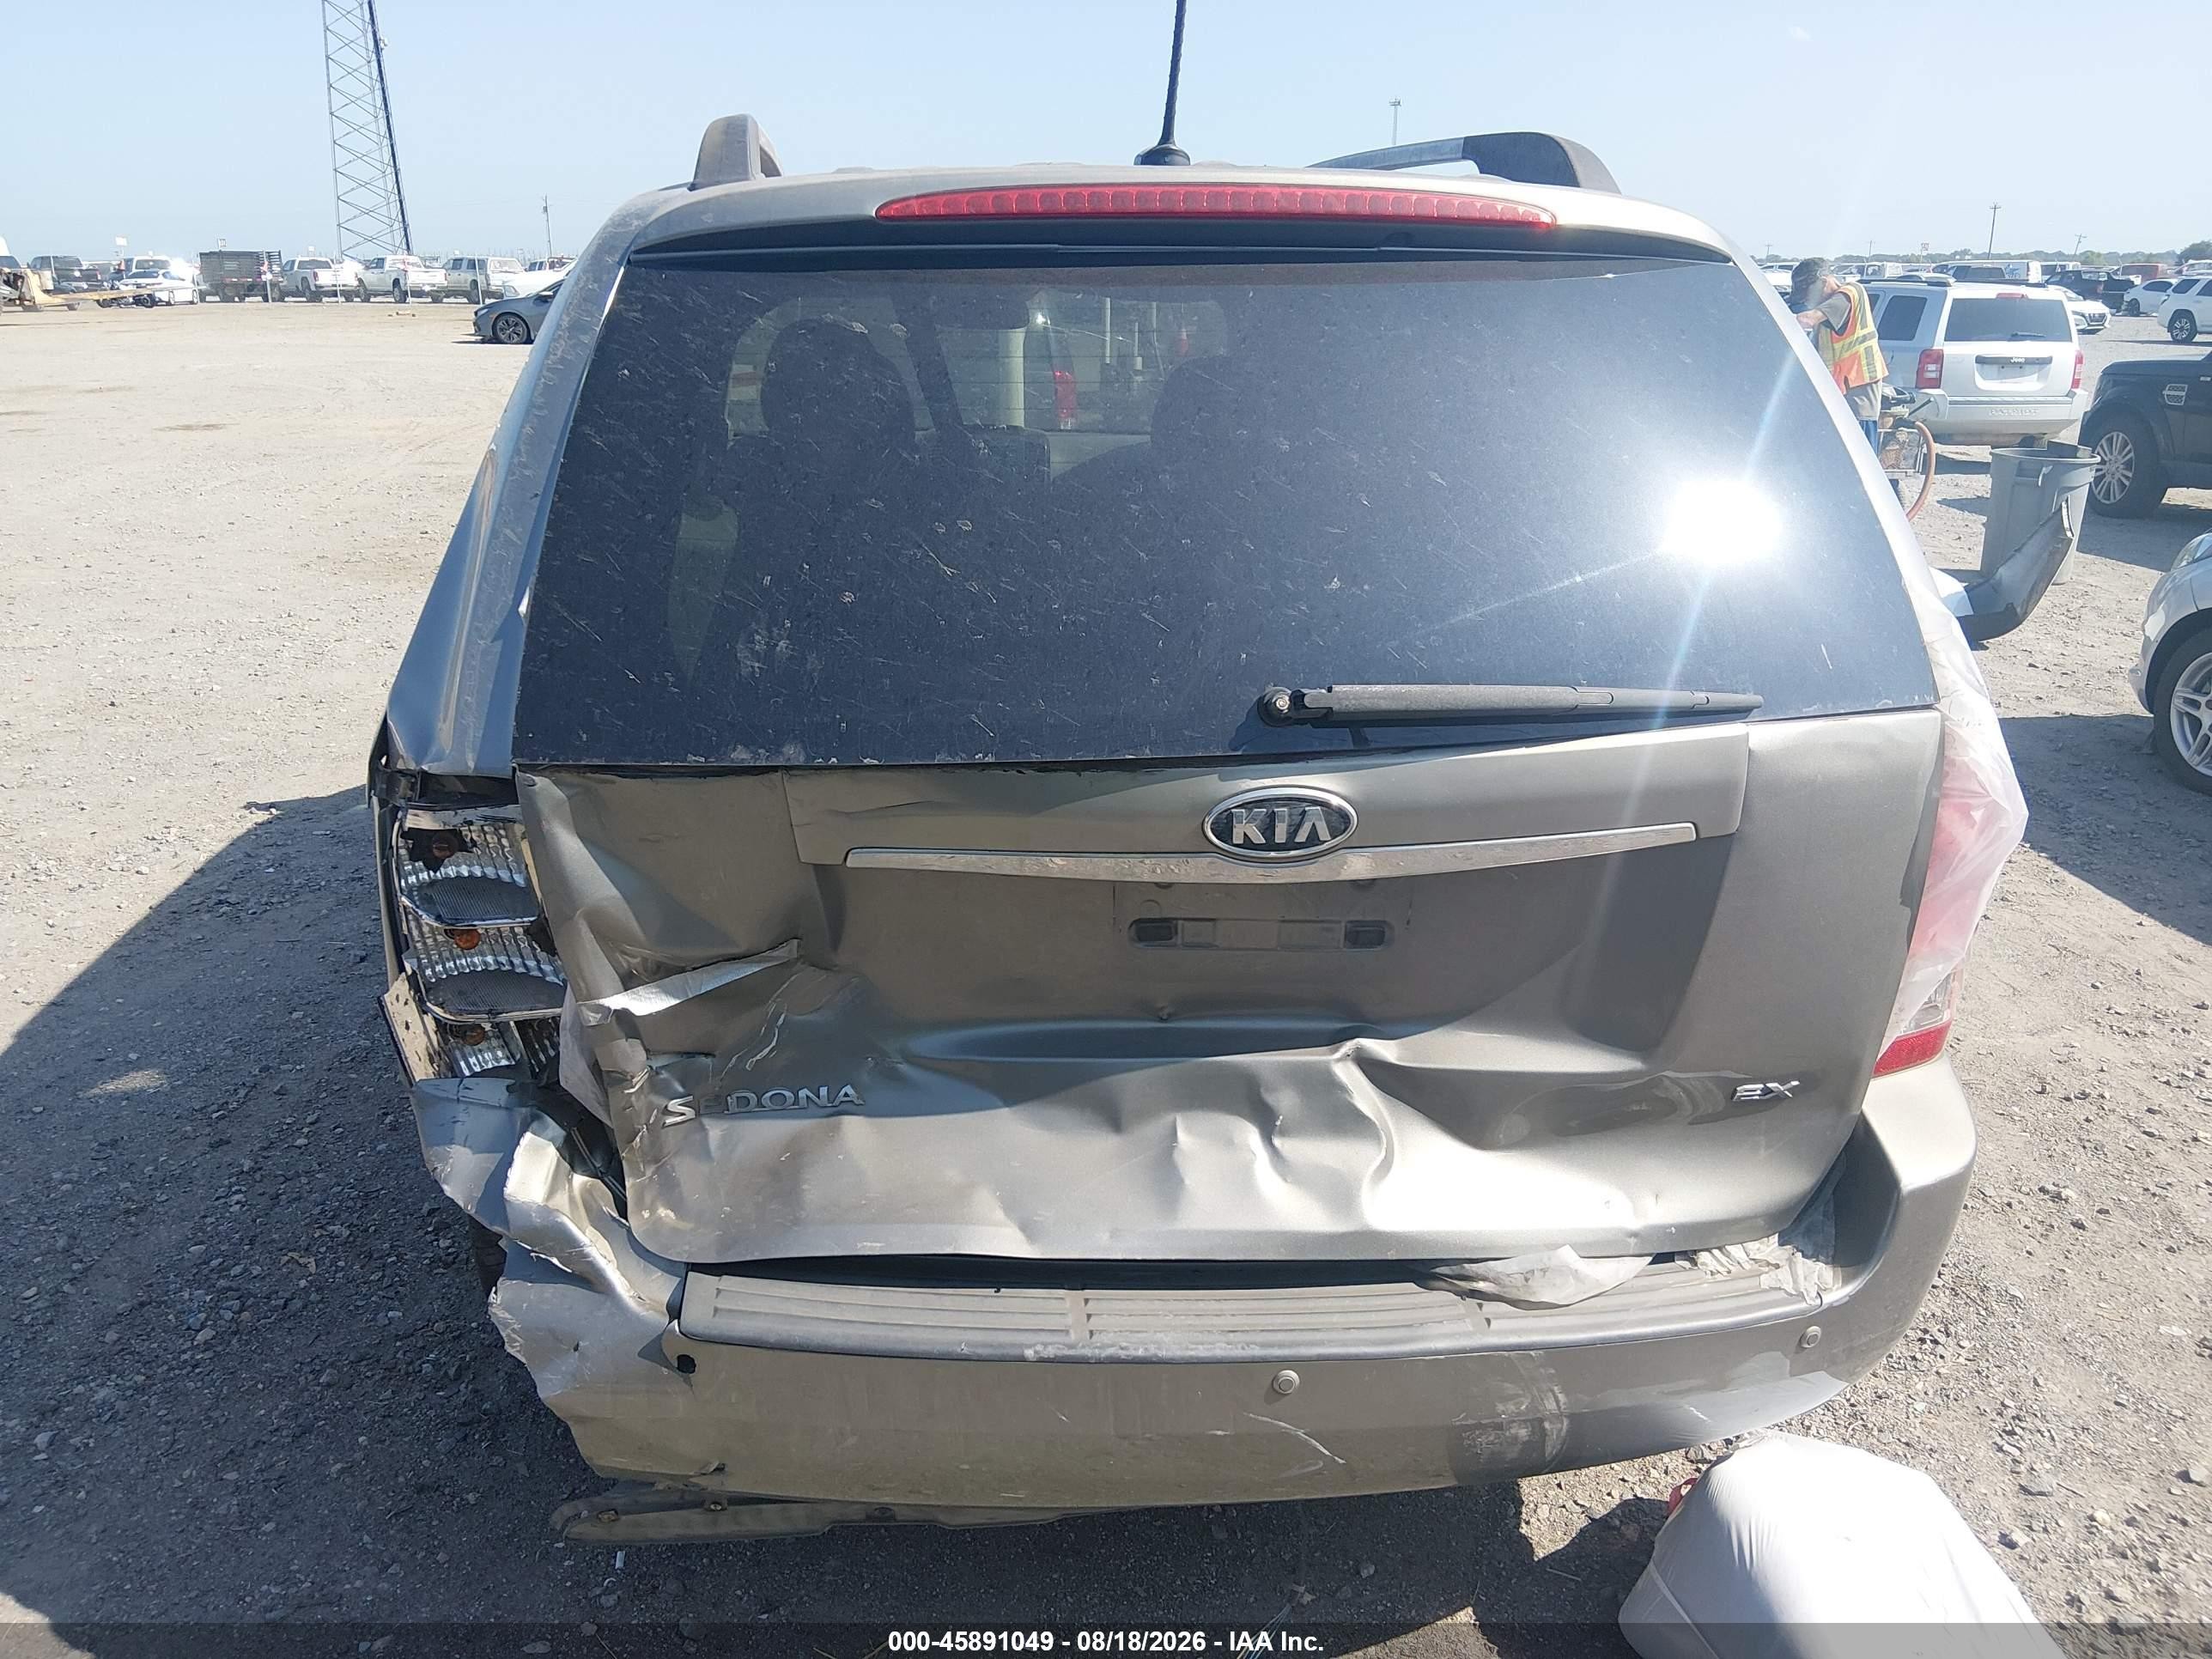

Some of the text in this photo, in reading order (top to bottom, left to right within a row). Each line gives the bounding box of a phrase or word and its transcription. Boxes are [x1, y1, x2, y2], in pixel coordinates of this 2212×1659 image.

[1231, 806, 1331, 844] KIA
[662, 1084, 866, 1127] SDONA
[1732, 1080, 1800, 1101] EX
